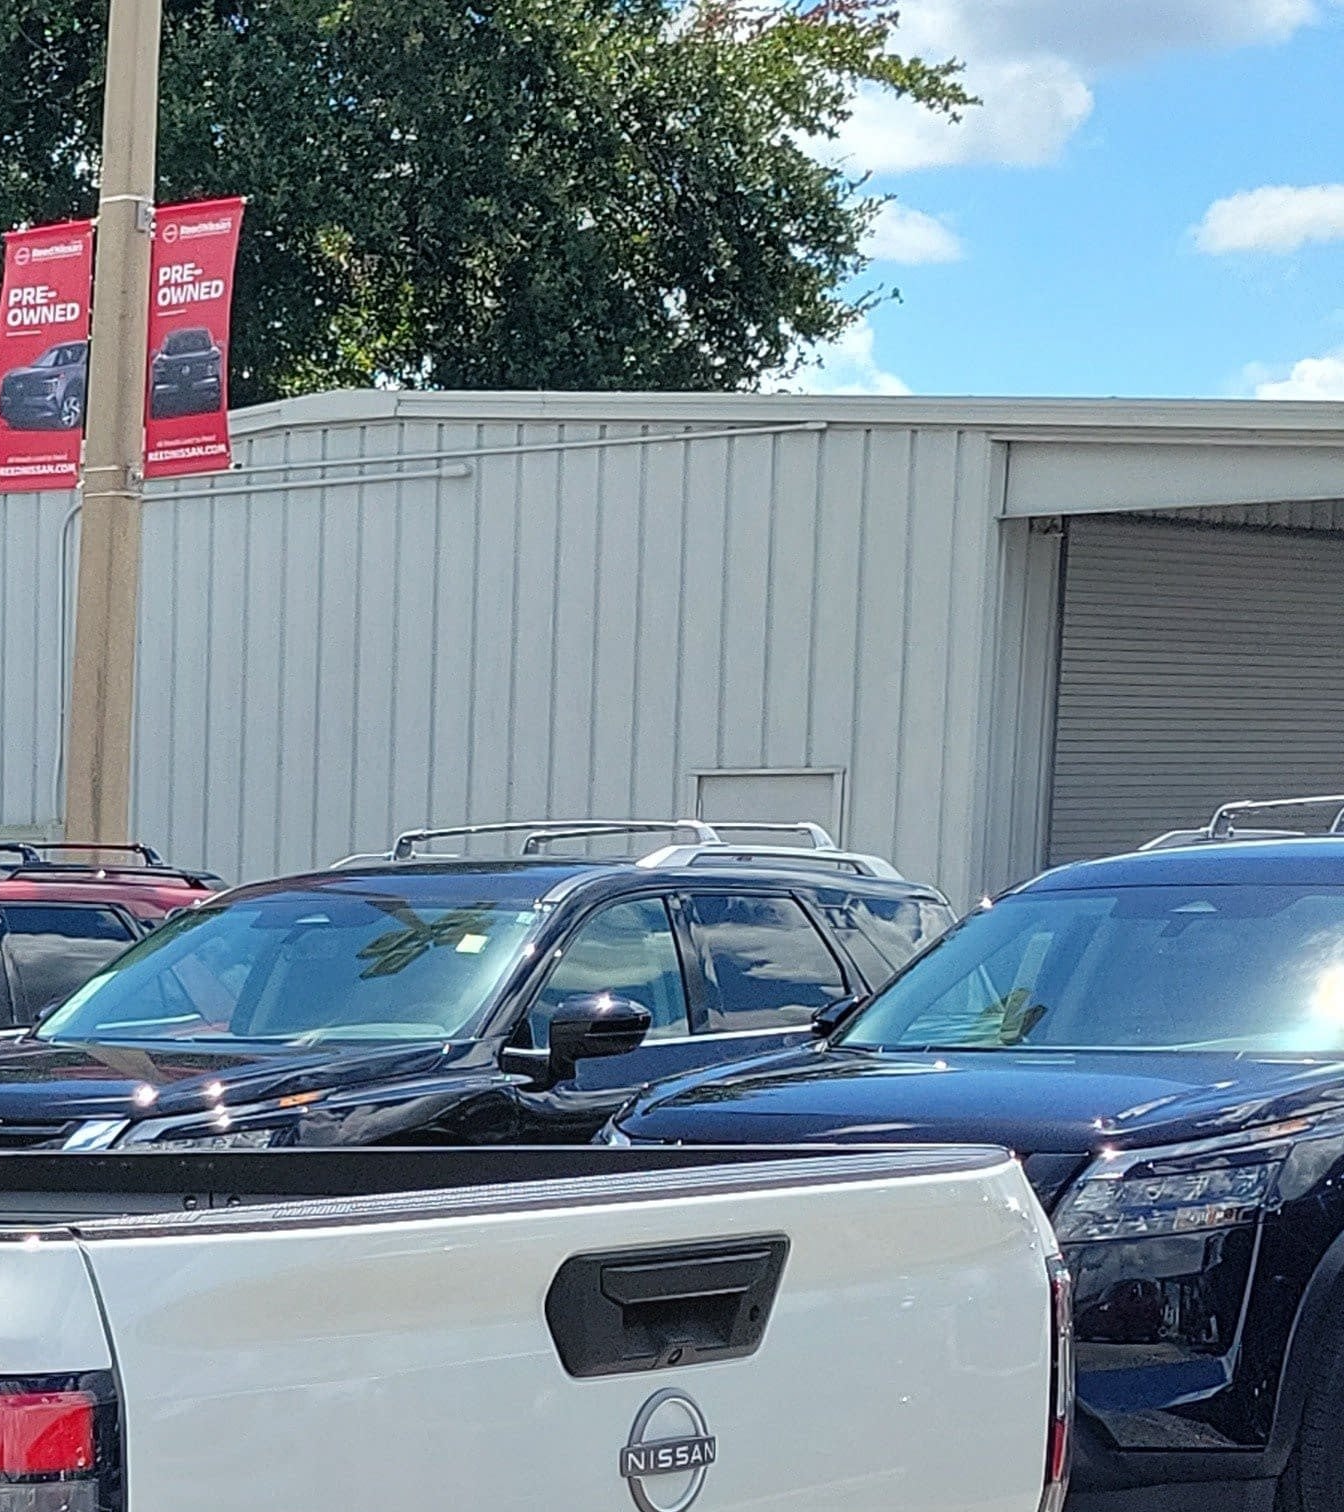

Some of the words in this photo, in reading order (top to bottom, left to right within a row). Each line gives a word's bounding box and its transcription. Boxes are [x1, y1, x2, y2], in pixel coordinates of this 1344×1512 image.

[158, 263, 203, 286] PRE-
[8, 285, 57, 307] PRE-
[157, 280, 225, 306] OWNED
[6, 303, 80, 326] OWNED
[627, 1440, 715, 1472] NISSAN
